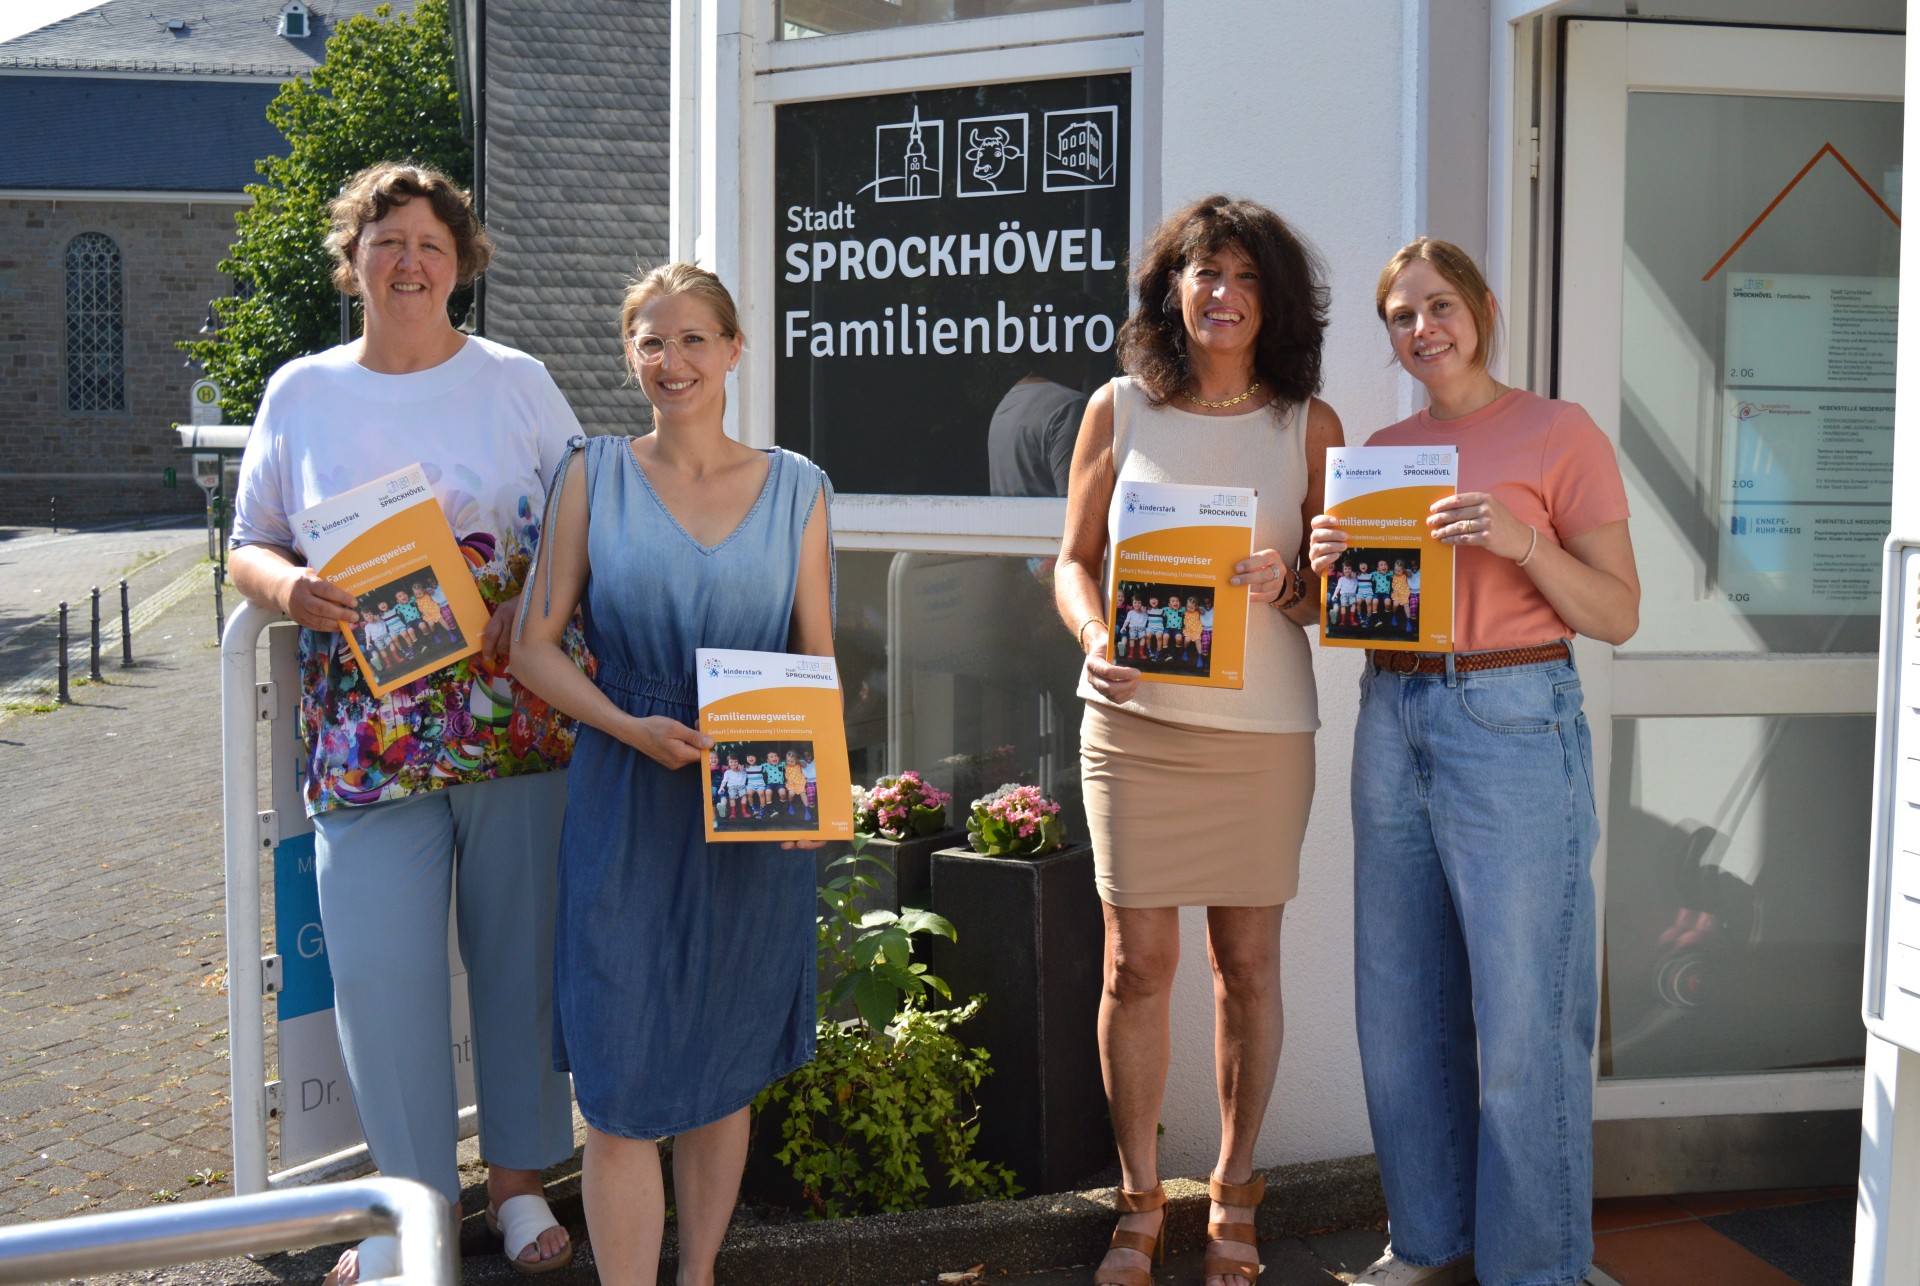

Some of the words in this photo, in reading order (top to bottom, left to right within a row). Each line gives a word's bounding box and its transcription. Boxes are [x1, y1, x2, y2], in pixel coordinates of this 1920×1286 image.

[787, 201, 856, 233] Stadt
[784, 221, 1117, 283] SPROCKHÖVEL
[785, 300, 1116, 358] Familienbüro
[1740, 368, 1754, 378] OG
[1345, 468, 1382, 476] kinderstark
[1403, 467, 1451, 476] SPROCKHÖVEL
[380, 485, 426, 508] SPROCKHÖVEL
[1138, 503, 1176, 513] kinderstark
[1198, 508, 1248, 517] SPROCKHÖVEL
[321, 511, 360, 532] kinderstark
[1336, 516, 1417, 528] milienwegweiser
[326, 540, 417, 584] Familienwegweiser
[1120, 550, 1213, 566] Familienwegweiser
[723, 668, 763, 676] kinderstark
[785, 672, 833, 681] SPROCKHÖVEL
[707, 712, 806, 723] Familienwegweiser
[301, 1078, 341, 1112] Dr.
